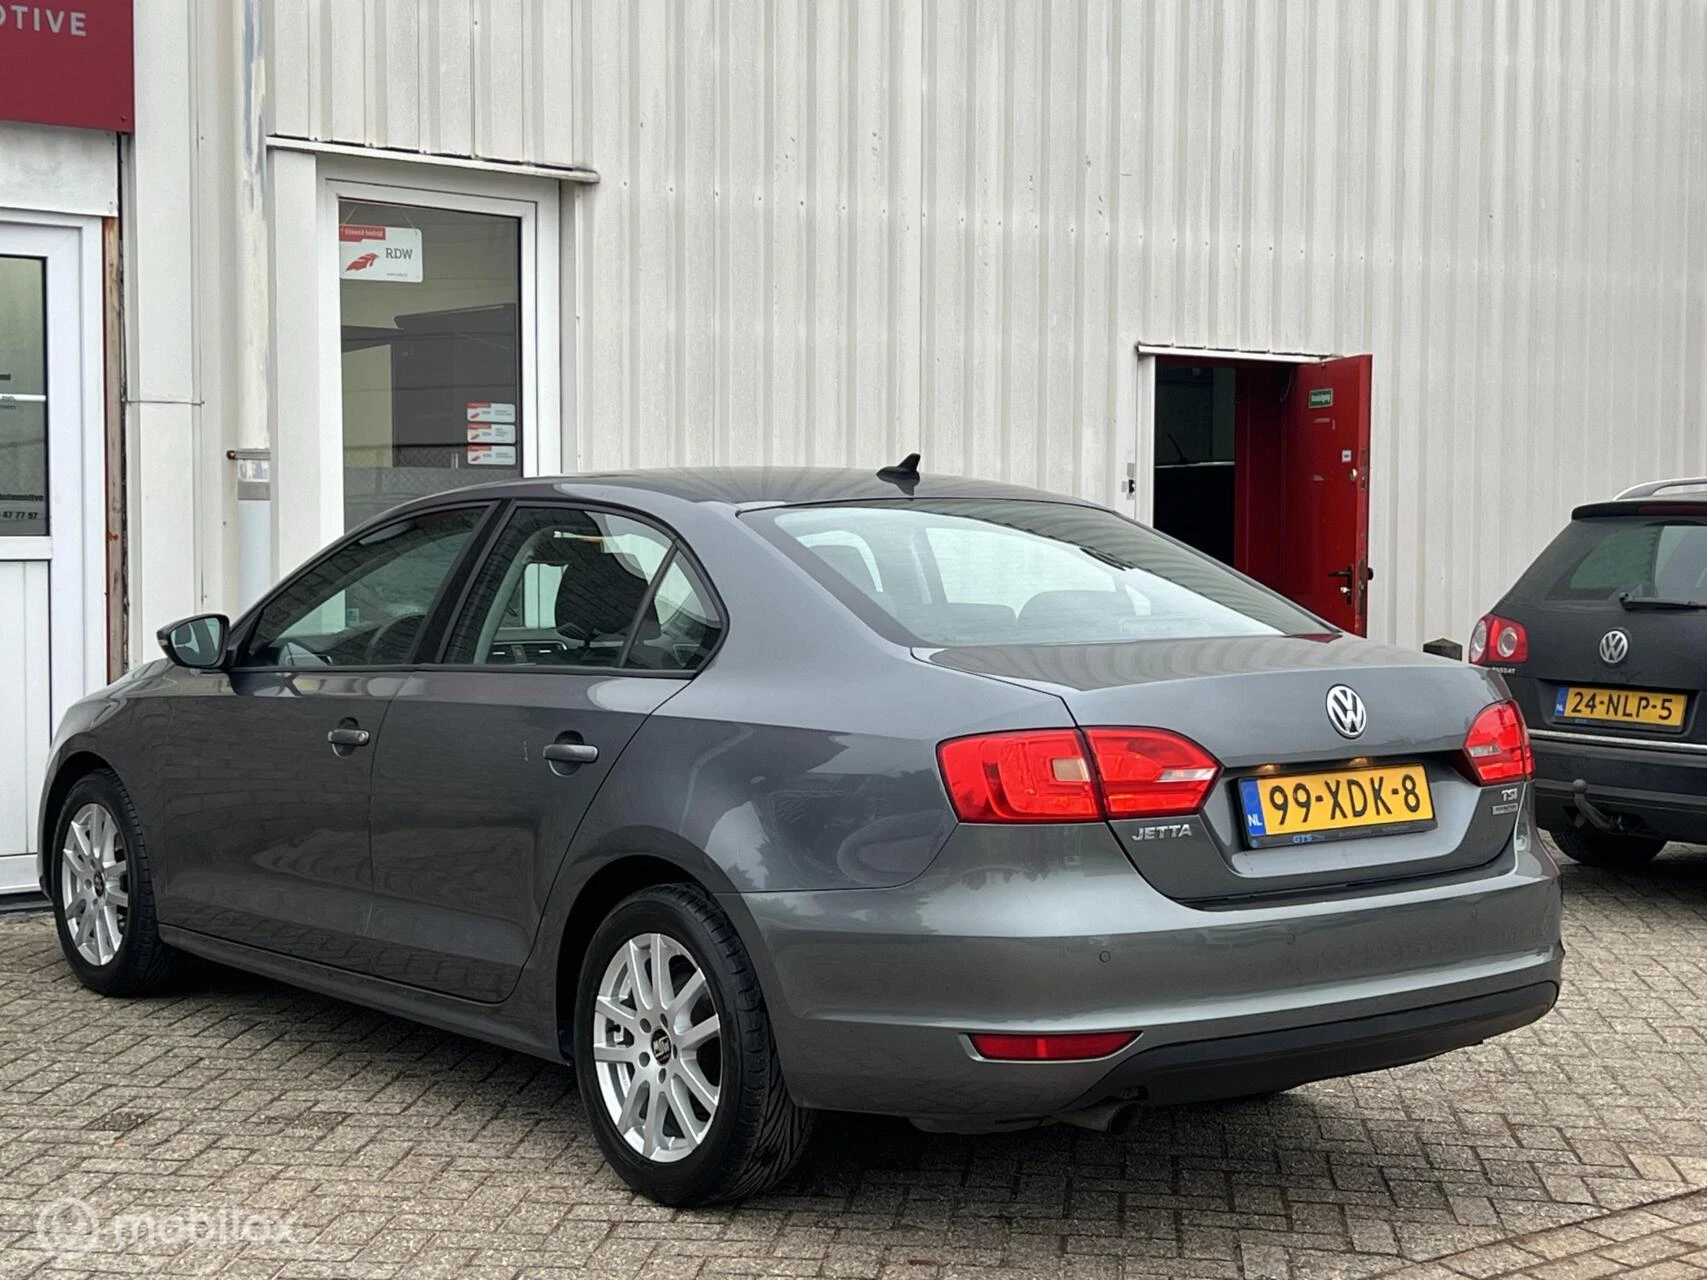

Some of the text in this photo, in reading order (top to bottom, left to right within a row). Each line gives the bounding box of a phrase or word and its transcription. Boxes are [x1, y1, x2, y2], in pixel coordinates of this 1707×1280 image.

[385, 247, 413, 260] RDW
[1571, 691, 1674, 721] 24-NLP-5
[1269, 773, 1421, 826] 99-XDK-8
[1247, 813, 1263, 827] NL
[1131, 823, 1193, 841] JETTA
